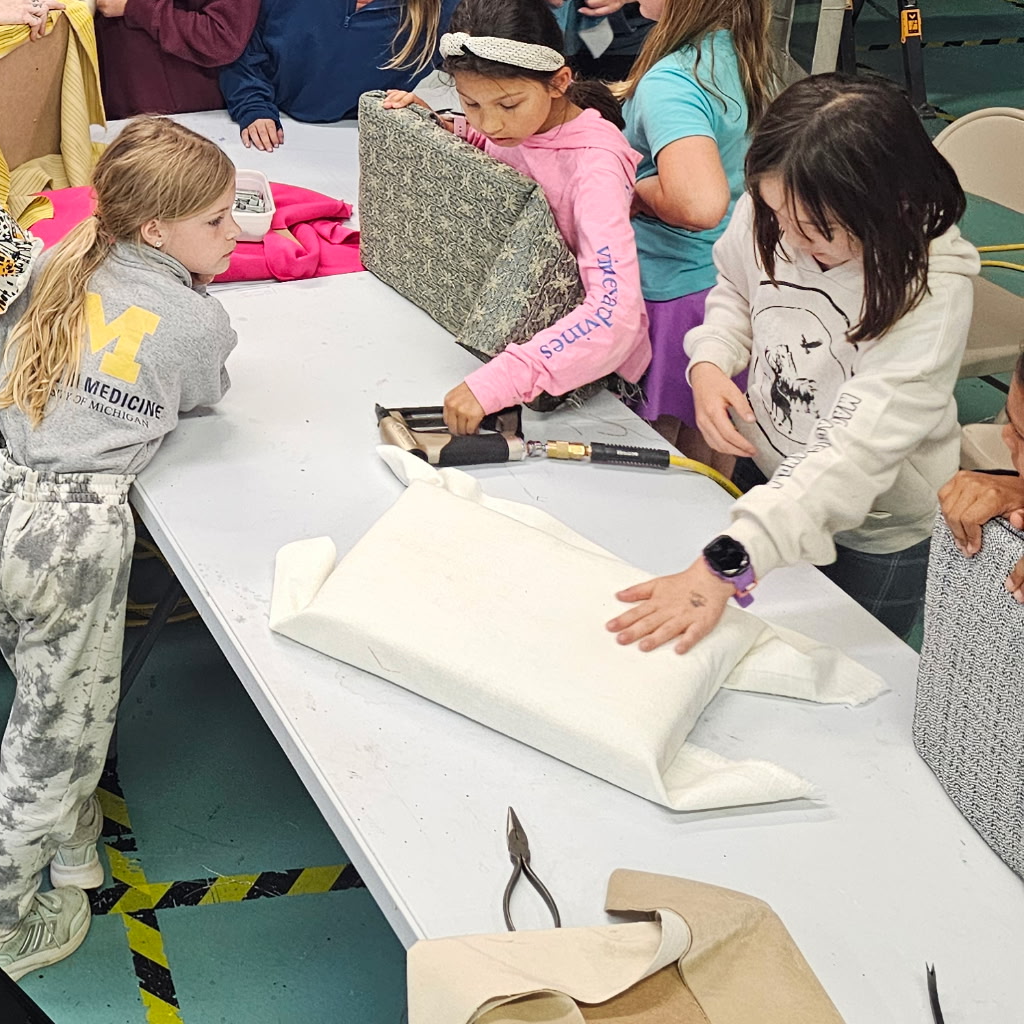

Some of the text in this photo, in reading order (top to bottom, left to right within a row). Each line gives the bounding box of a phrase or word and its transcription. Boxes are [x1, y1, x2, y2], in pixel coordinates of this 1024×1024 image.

[595, 246, 619, 328] vinead
[84, 291, 161, 384] M
[540, 318, 601, 359] vines
[84, 377, 165, 419] MEDICINE
[89, 400, 150, 429] MICHIGAN
